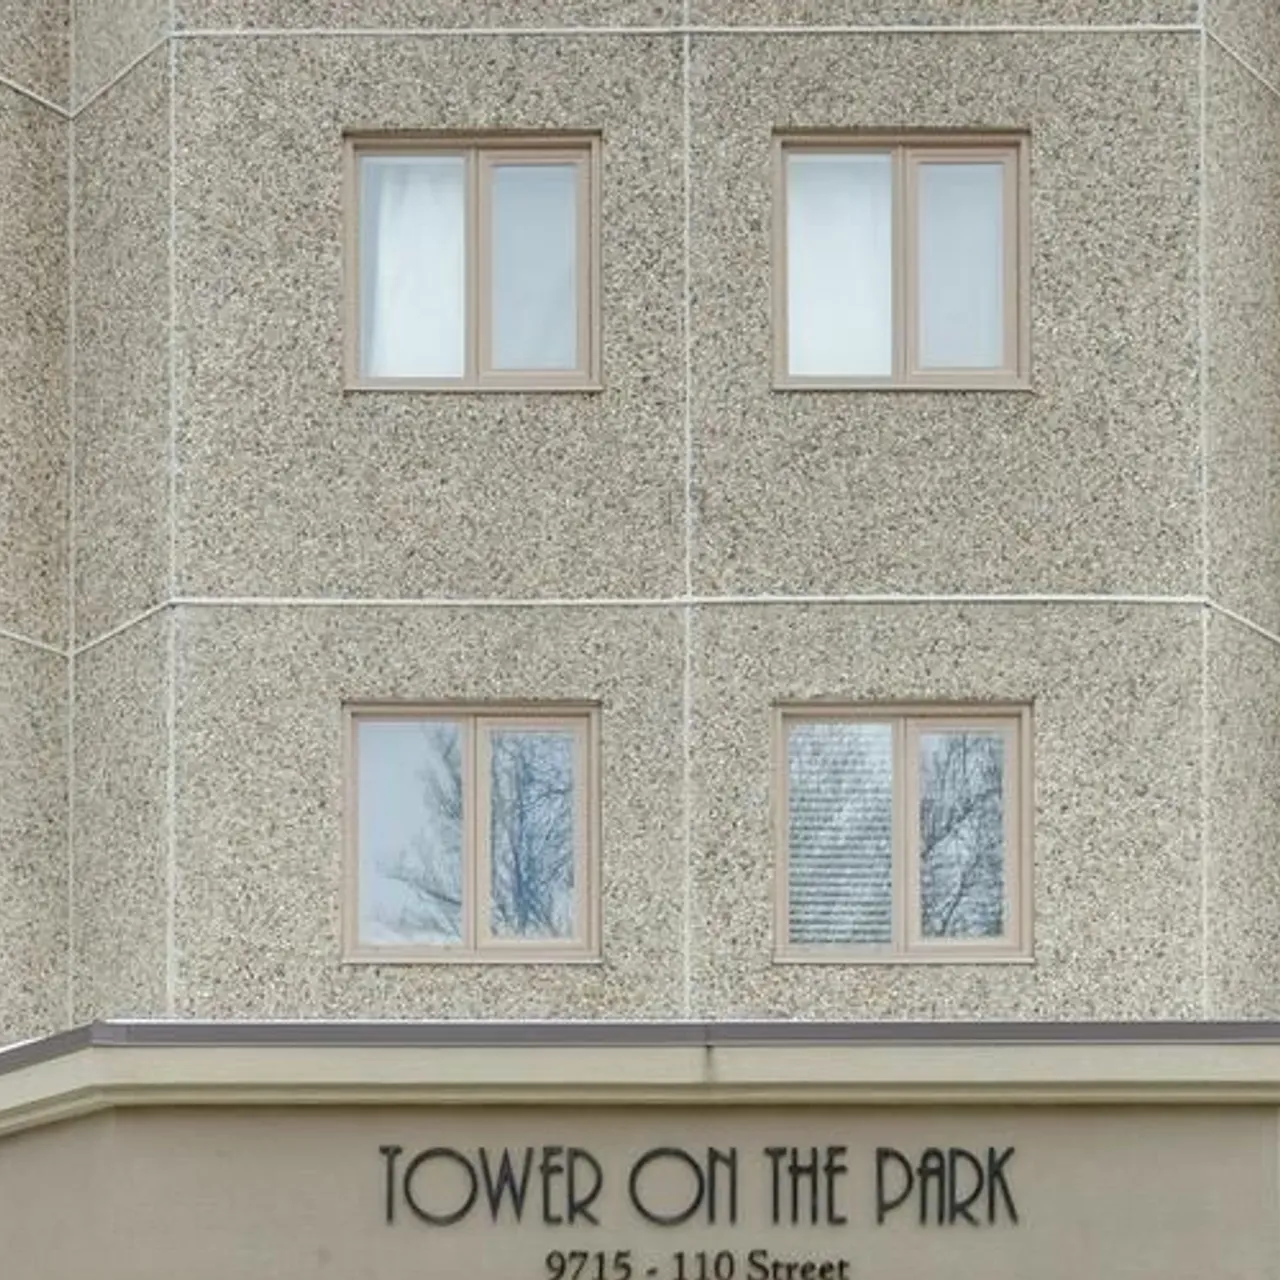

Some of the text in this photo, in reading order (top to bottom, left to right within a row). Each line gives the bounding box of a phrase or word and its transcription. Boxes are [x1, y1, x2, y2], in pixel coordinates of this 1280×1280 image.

[378, 1145, 1019, 1228] TOWER ON THE PARK
